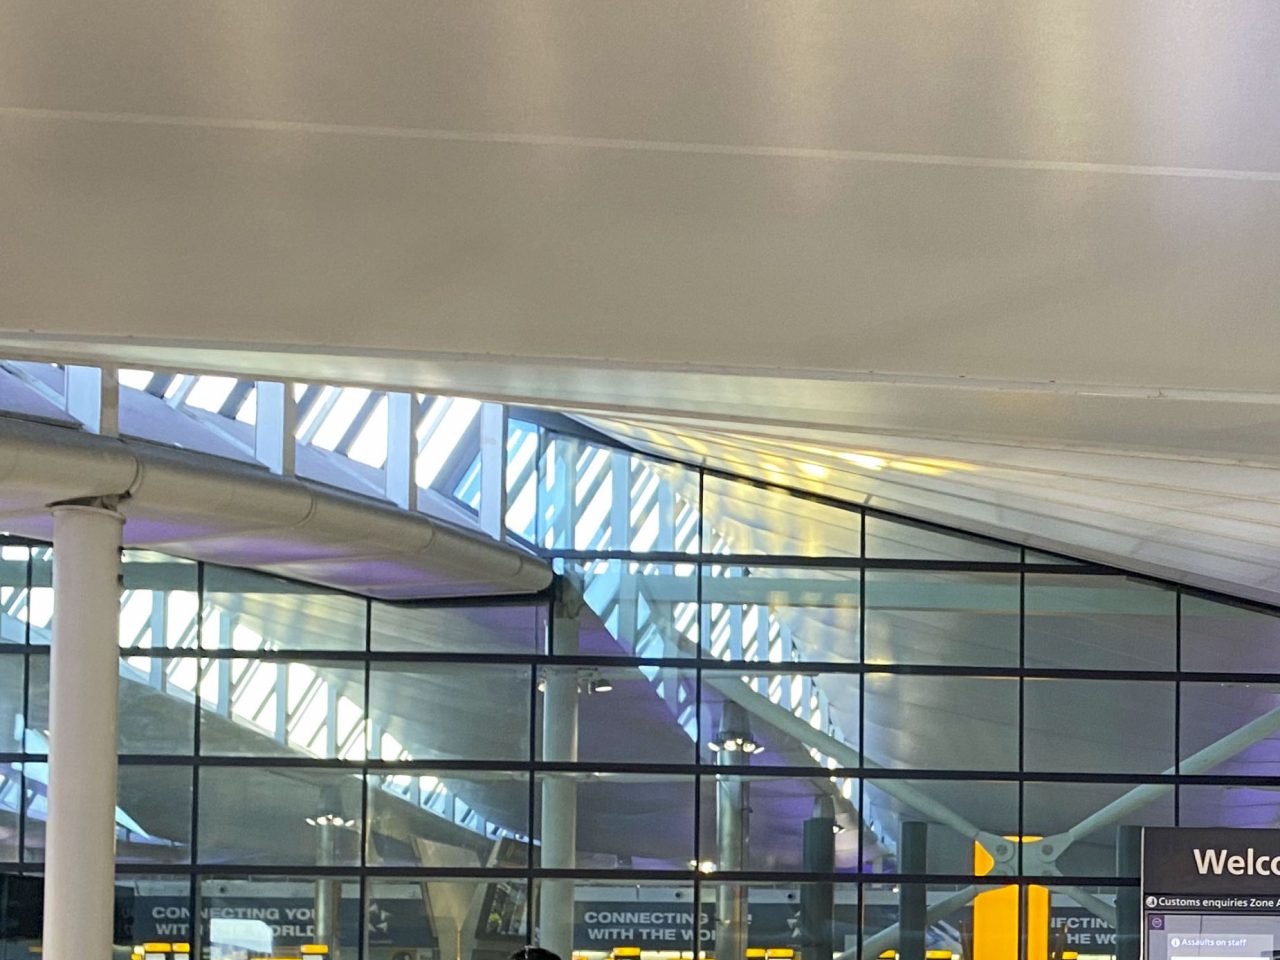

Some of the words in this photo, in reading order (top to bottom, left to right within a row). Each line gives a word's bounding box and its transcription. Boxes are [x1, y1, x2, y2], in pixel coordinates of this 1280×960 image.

[1158, 897, 1200, 907] Customs
[1202, 897, 1247, 909] enquiries
[1249, 899, 1274, 908] Zone
[584, 911, 709, 924] CONNECTING
[588, 928, 634, 941] WITH
[638, 928, 676, 941] THE
[1181, 938, 1214, 946] Assaults
[1228, 938, 1247, 946] staff
